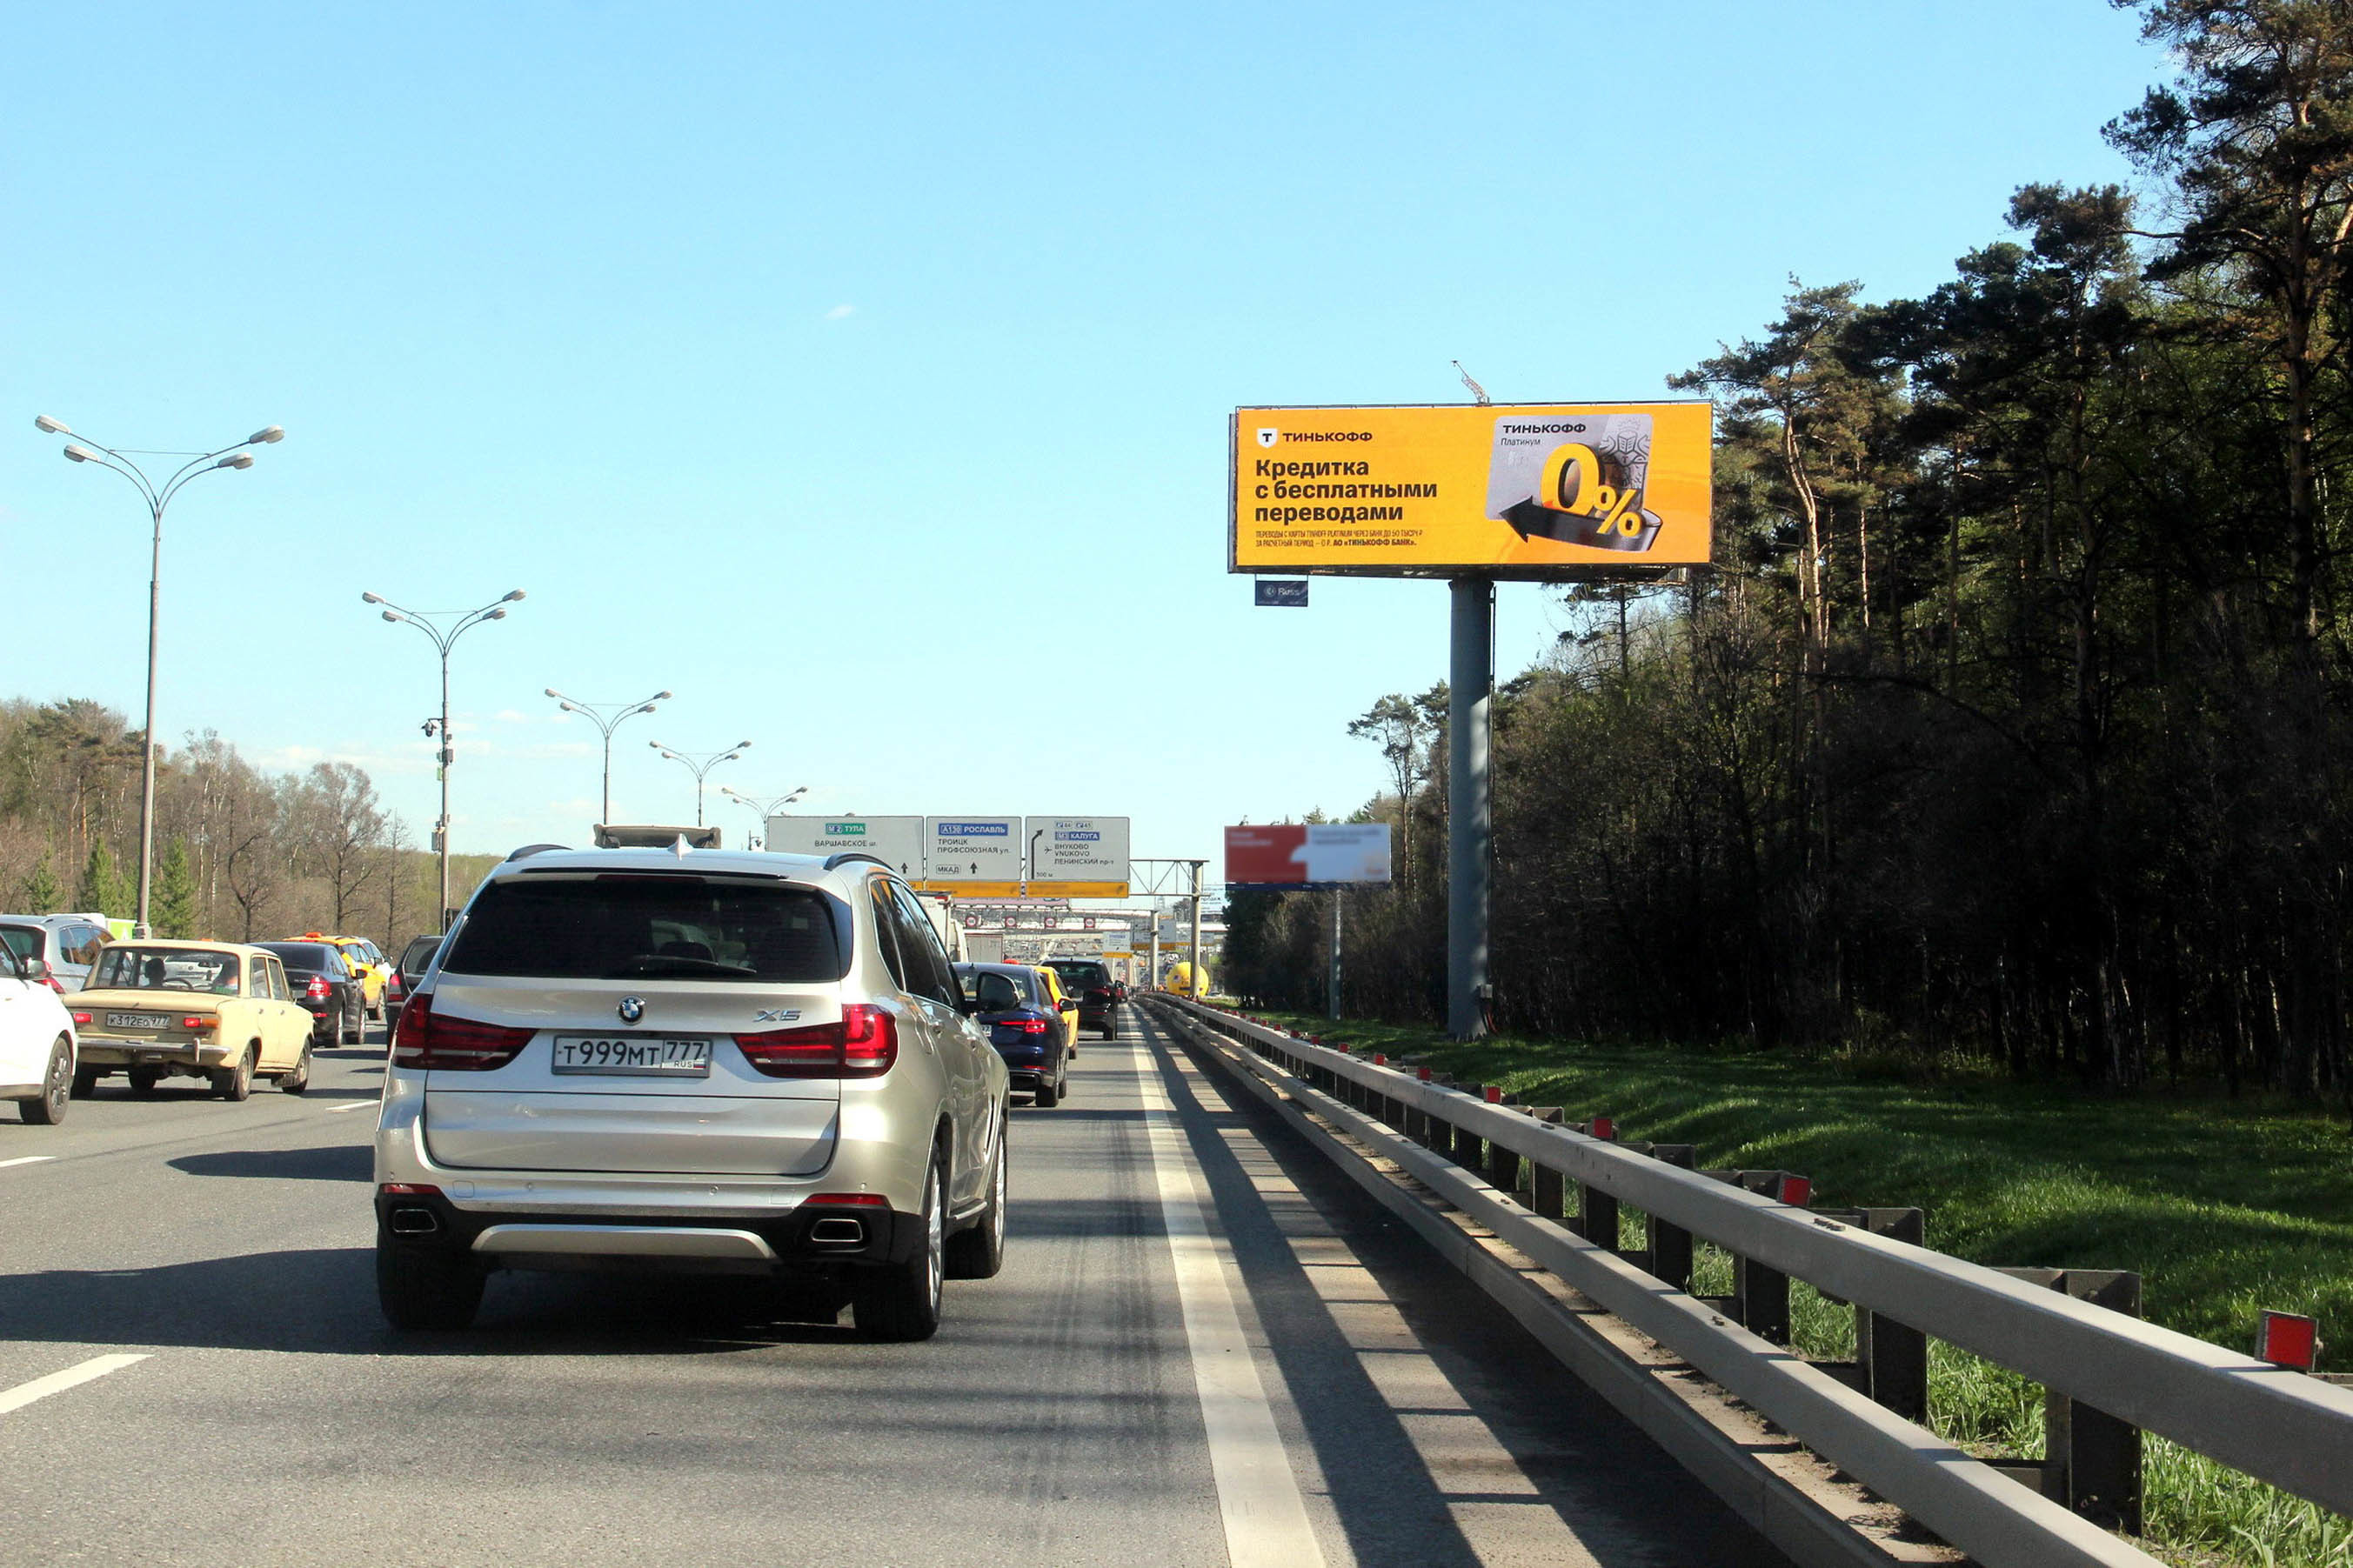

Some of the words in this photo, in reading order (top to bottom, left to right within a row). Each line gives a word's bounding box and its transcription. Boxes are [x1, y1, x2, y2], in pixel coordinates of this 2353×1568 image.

[1502, 423, 1587, 434] ТИНЬКОФФ
[1282, 431, 1374, 443] ТИНЬКОФФ
[1501, 437, 1541, 447] Платинум
[1255, 459, 1370, 481] Кредитка
[1254, 484, 1269, 499] с
[1273, 480, 1438, 499] бесплатными
[1254, 506, 1403, 525] переводами
[964, 825, 1006, 834] РОСЛАВЛЬ
[814, 839, 867, 848] ВАРШАВСКОЕ
[752, 1009, 802, 1023] X5
[673, 1060, 693, 1069] RUS
